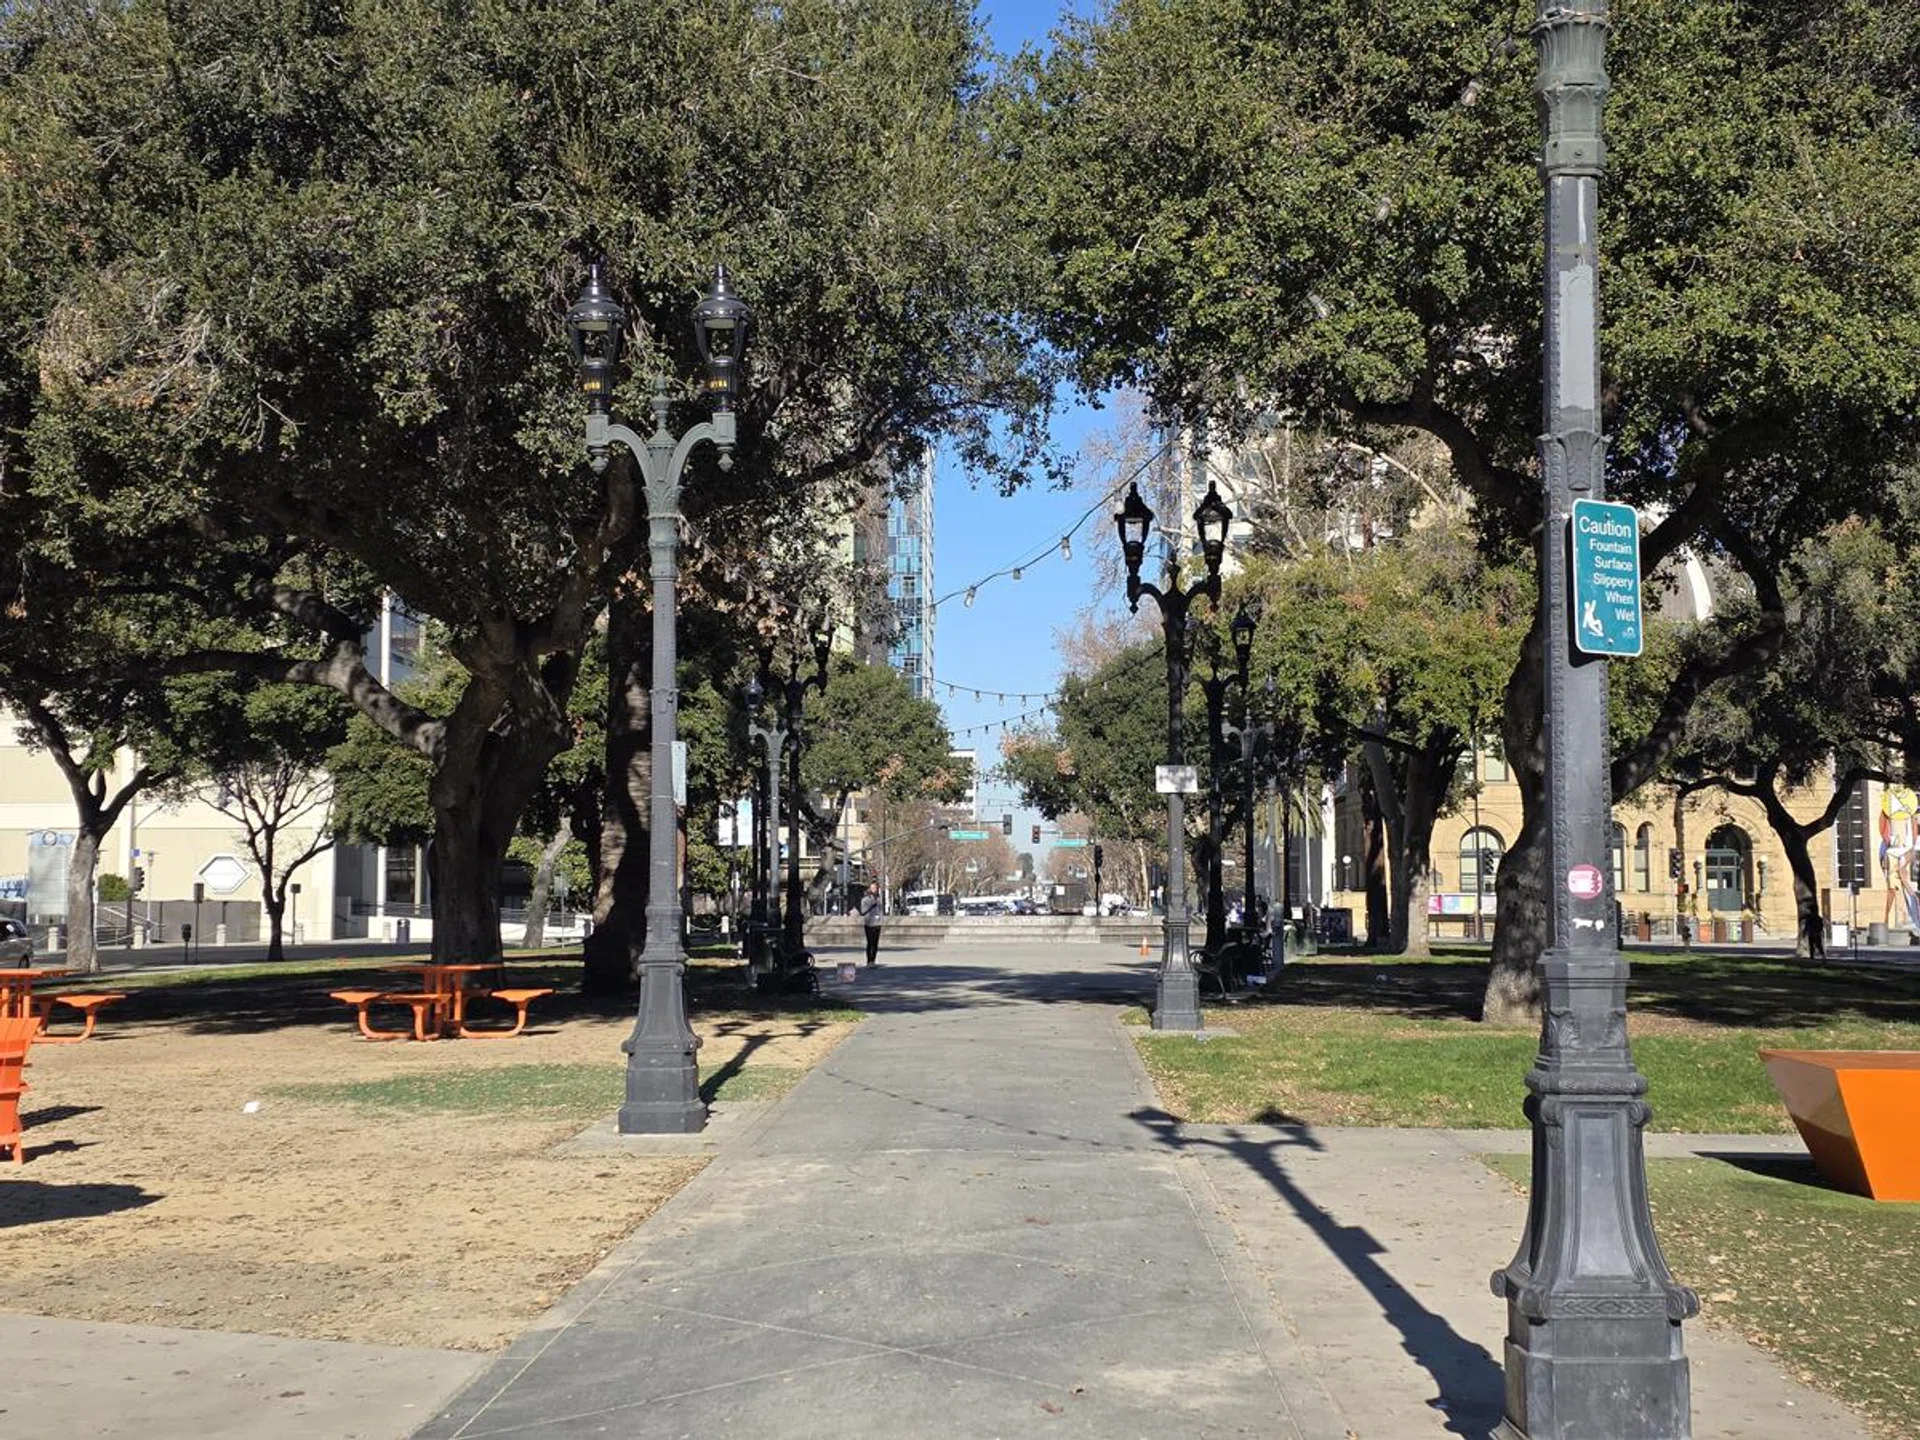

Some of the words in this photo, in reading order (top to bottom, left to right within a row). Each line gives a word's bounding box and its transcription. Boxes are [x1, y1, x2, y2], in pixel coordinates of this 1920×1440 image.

[1579, 516, 1632, 538] Caution
[1589, 538, 1632, 555] Fountain
[1594, 556, 1633, 572] Surface
[1593, 573, 1634, 591] Slippery
[1605, 591, 1635, 605] When
[1615, 608, 1635, 622] Wet
